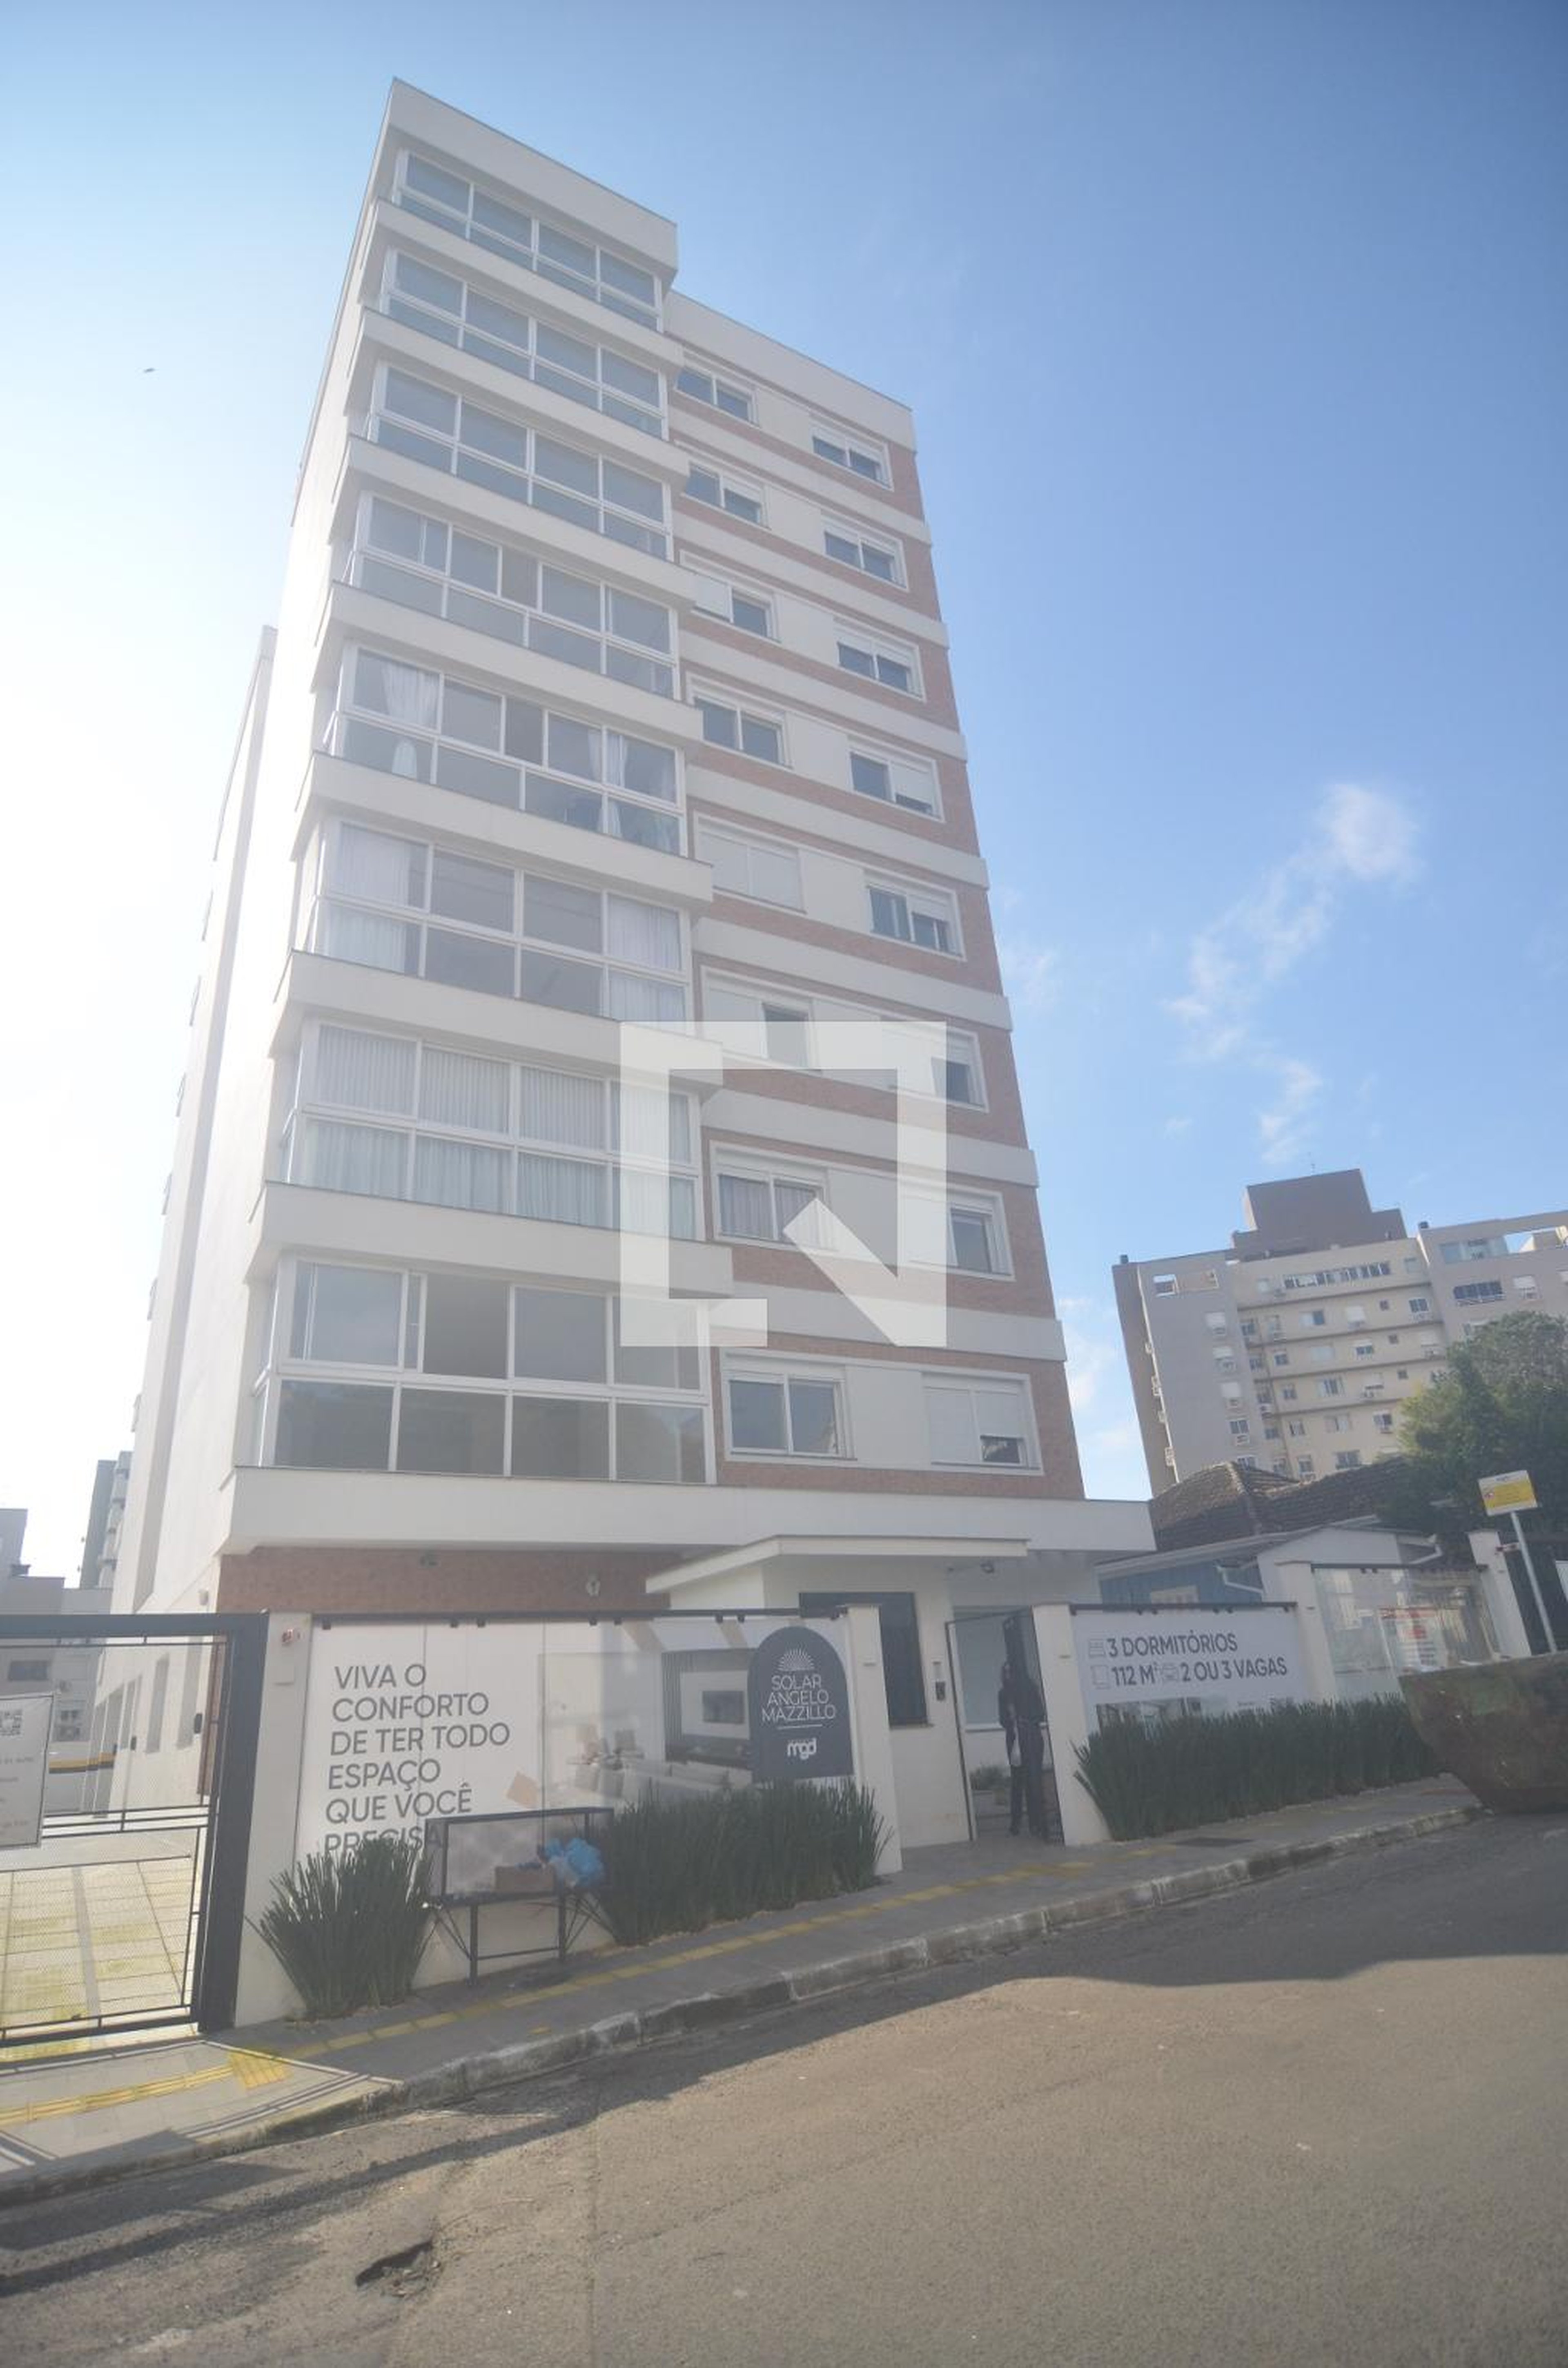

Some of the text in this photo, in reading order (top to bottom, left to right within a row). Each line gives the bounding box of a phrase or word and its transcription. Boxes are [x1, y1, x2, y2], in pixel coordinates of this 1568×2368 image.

[1107, 1630, 1238, 1657] 3 DORMITÓRIOS
[334, 1664, 426, 1689] VIVA O
[771, 1674, 821, 1690] SOLAR
[1112, 1666, 1136, 1686] 112
[1180, 1662, 1191, 1681] 2
[1194, 1661, 1218, 1681] OU
[1221, 1660, 1232, 1679] 3
[1233, 1657, 1287, 1678] VAGAS
[332, 1692, 489, 1722] CONFORTO
[767, 1689, 829, 1707] ANGELO
[762, 1704, 836, 1722] MAZZILLO
[330, 1722, 510, 1756] DE TER TODO
[328, 1759, 441, 1791] ESPAÇO
[326, 1782, 472, 1824] QUE VOCÊ
